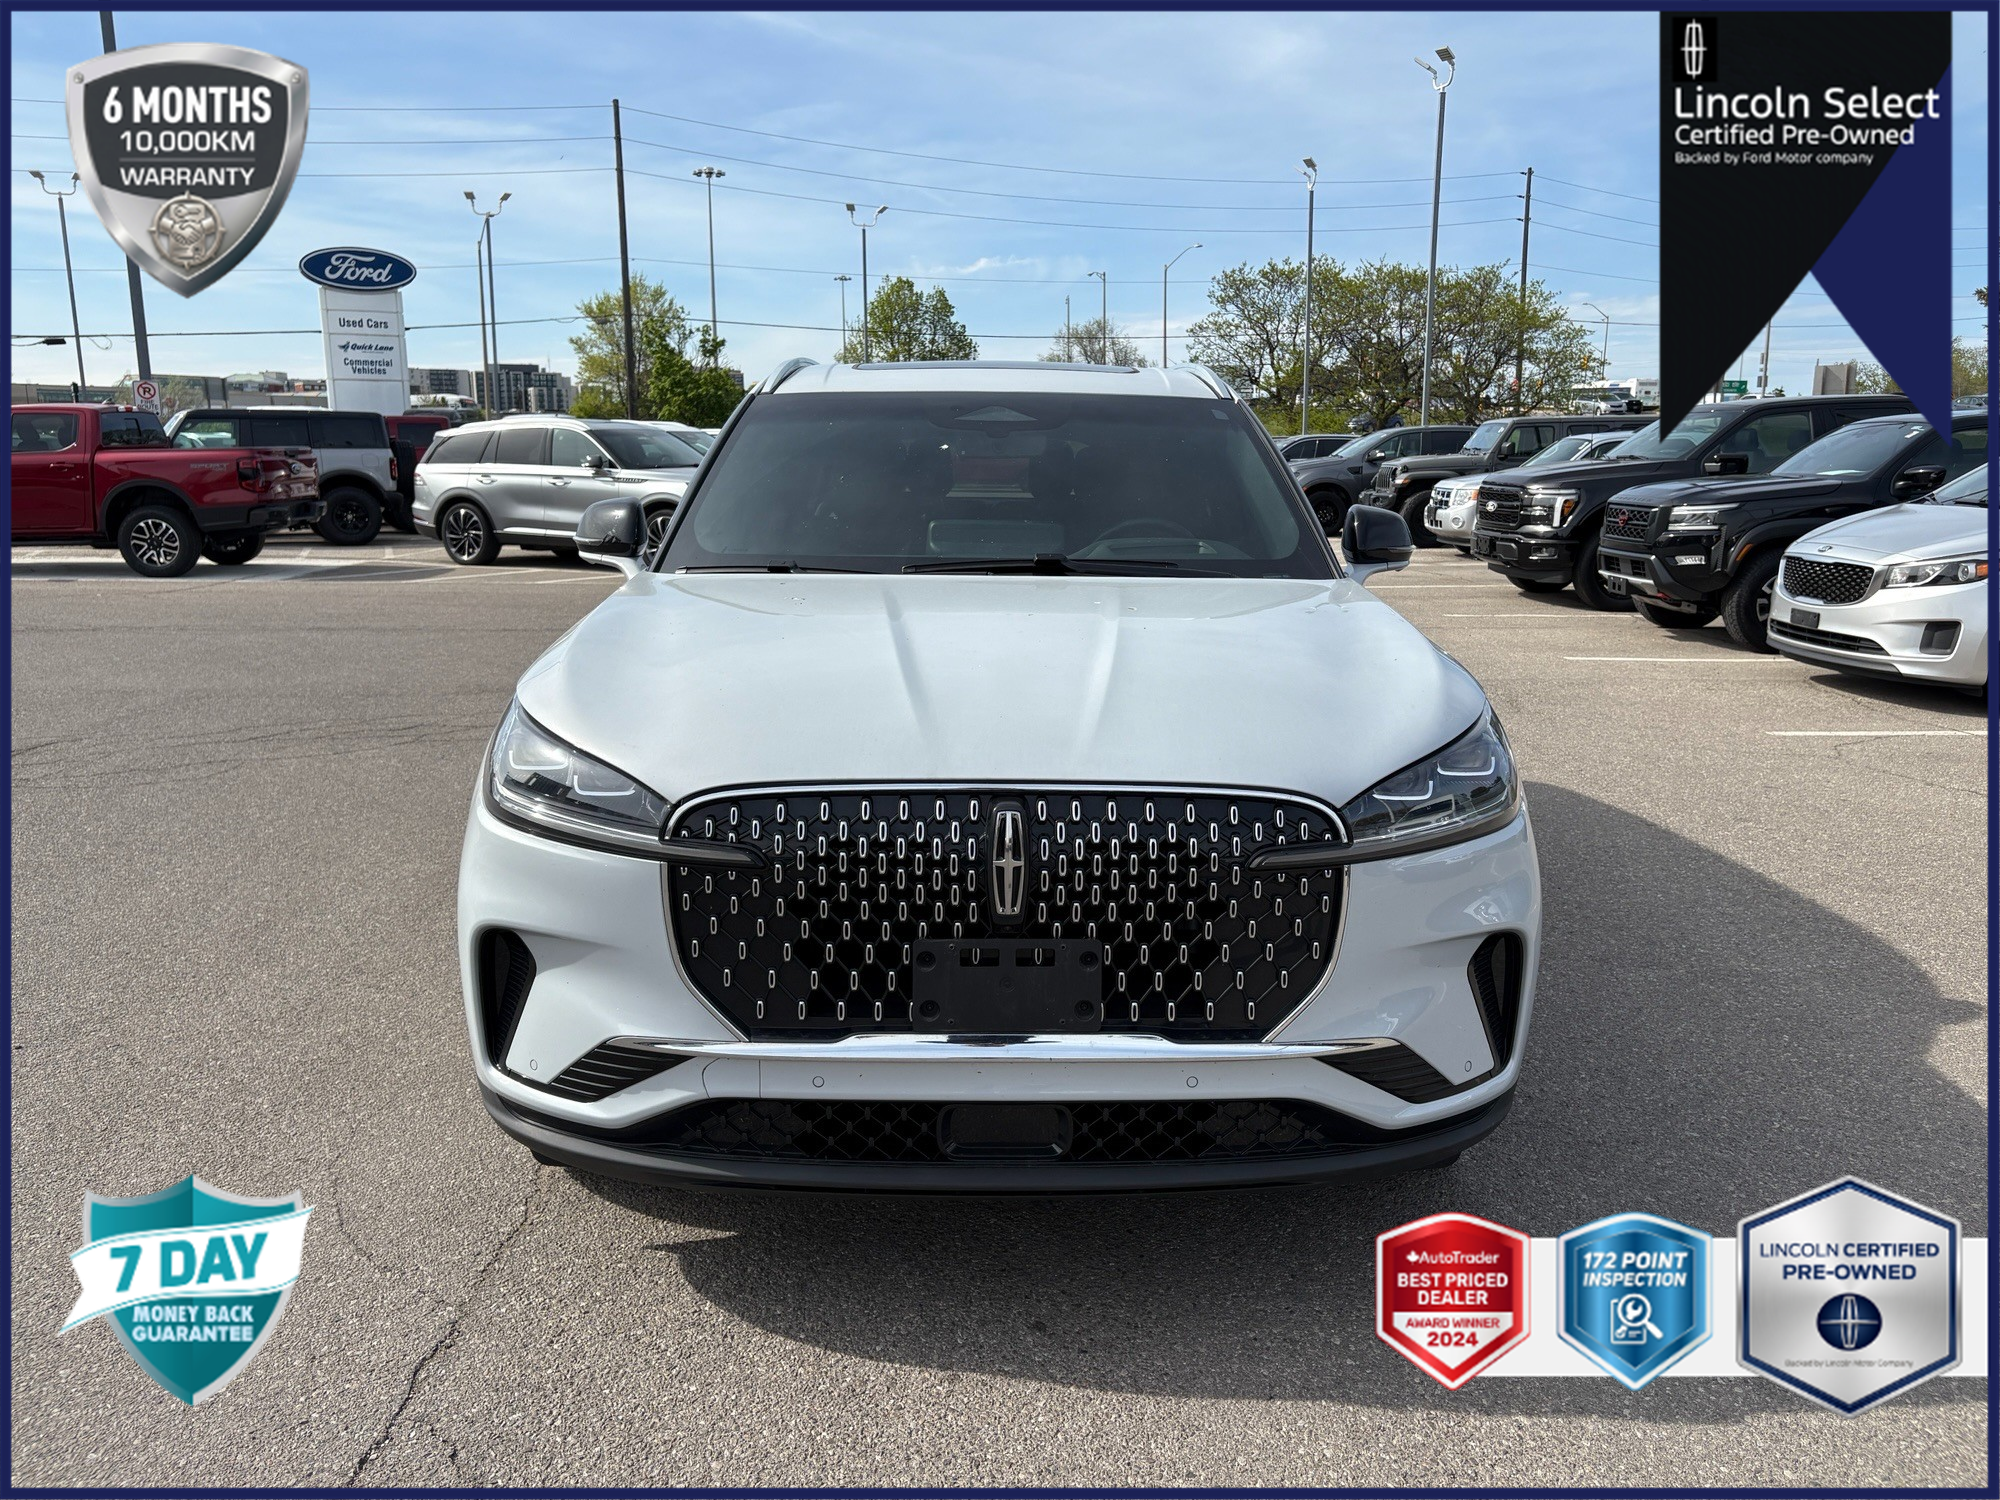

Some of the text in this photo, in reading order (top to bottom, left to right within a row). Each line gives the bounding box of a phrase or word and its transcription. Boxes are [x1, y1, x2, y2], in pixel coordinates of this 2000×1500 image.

[324, 253, 393, 283] Ford
[338, 317, 389, 329] Used Cars
[350, 342, 394, 352] Quick Lane
[343, 357, 393, 368] Commercial
[351, 366, 387, 375] Vehicles
